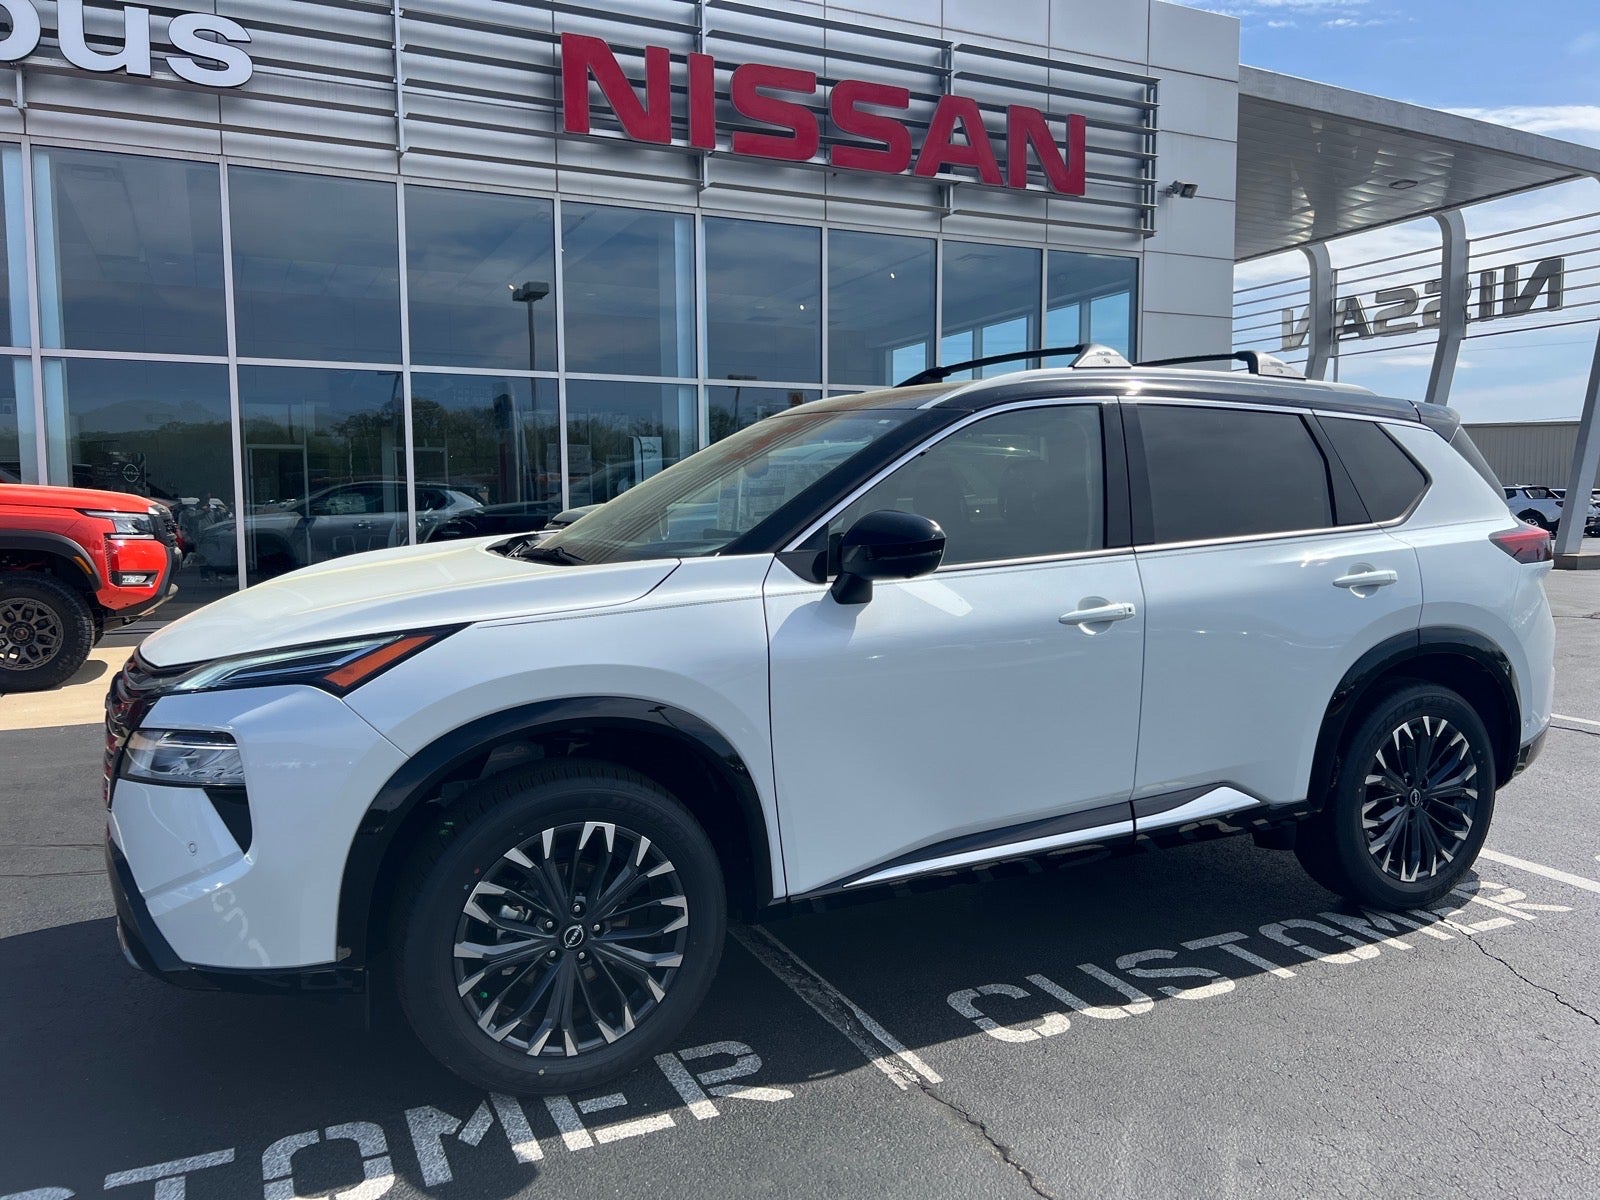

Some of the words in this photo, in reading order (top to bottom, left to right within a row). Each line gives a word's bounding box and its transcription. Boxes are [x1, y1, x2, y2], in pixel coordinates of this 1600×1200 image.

[560, 32, 1086, 196] NISSAN
[946, 881, 1573, 1043] CUSTOMER
[0, 1040, 795, 1200] TOMER
